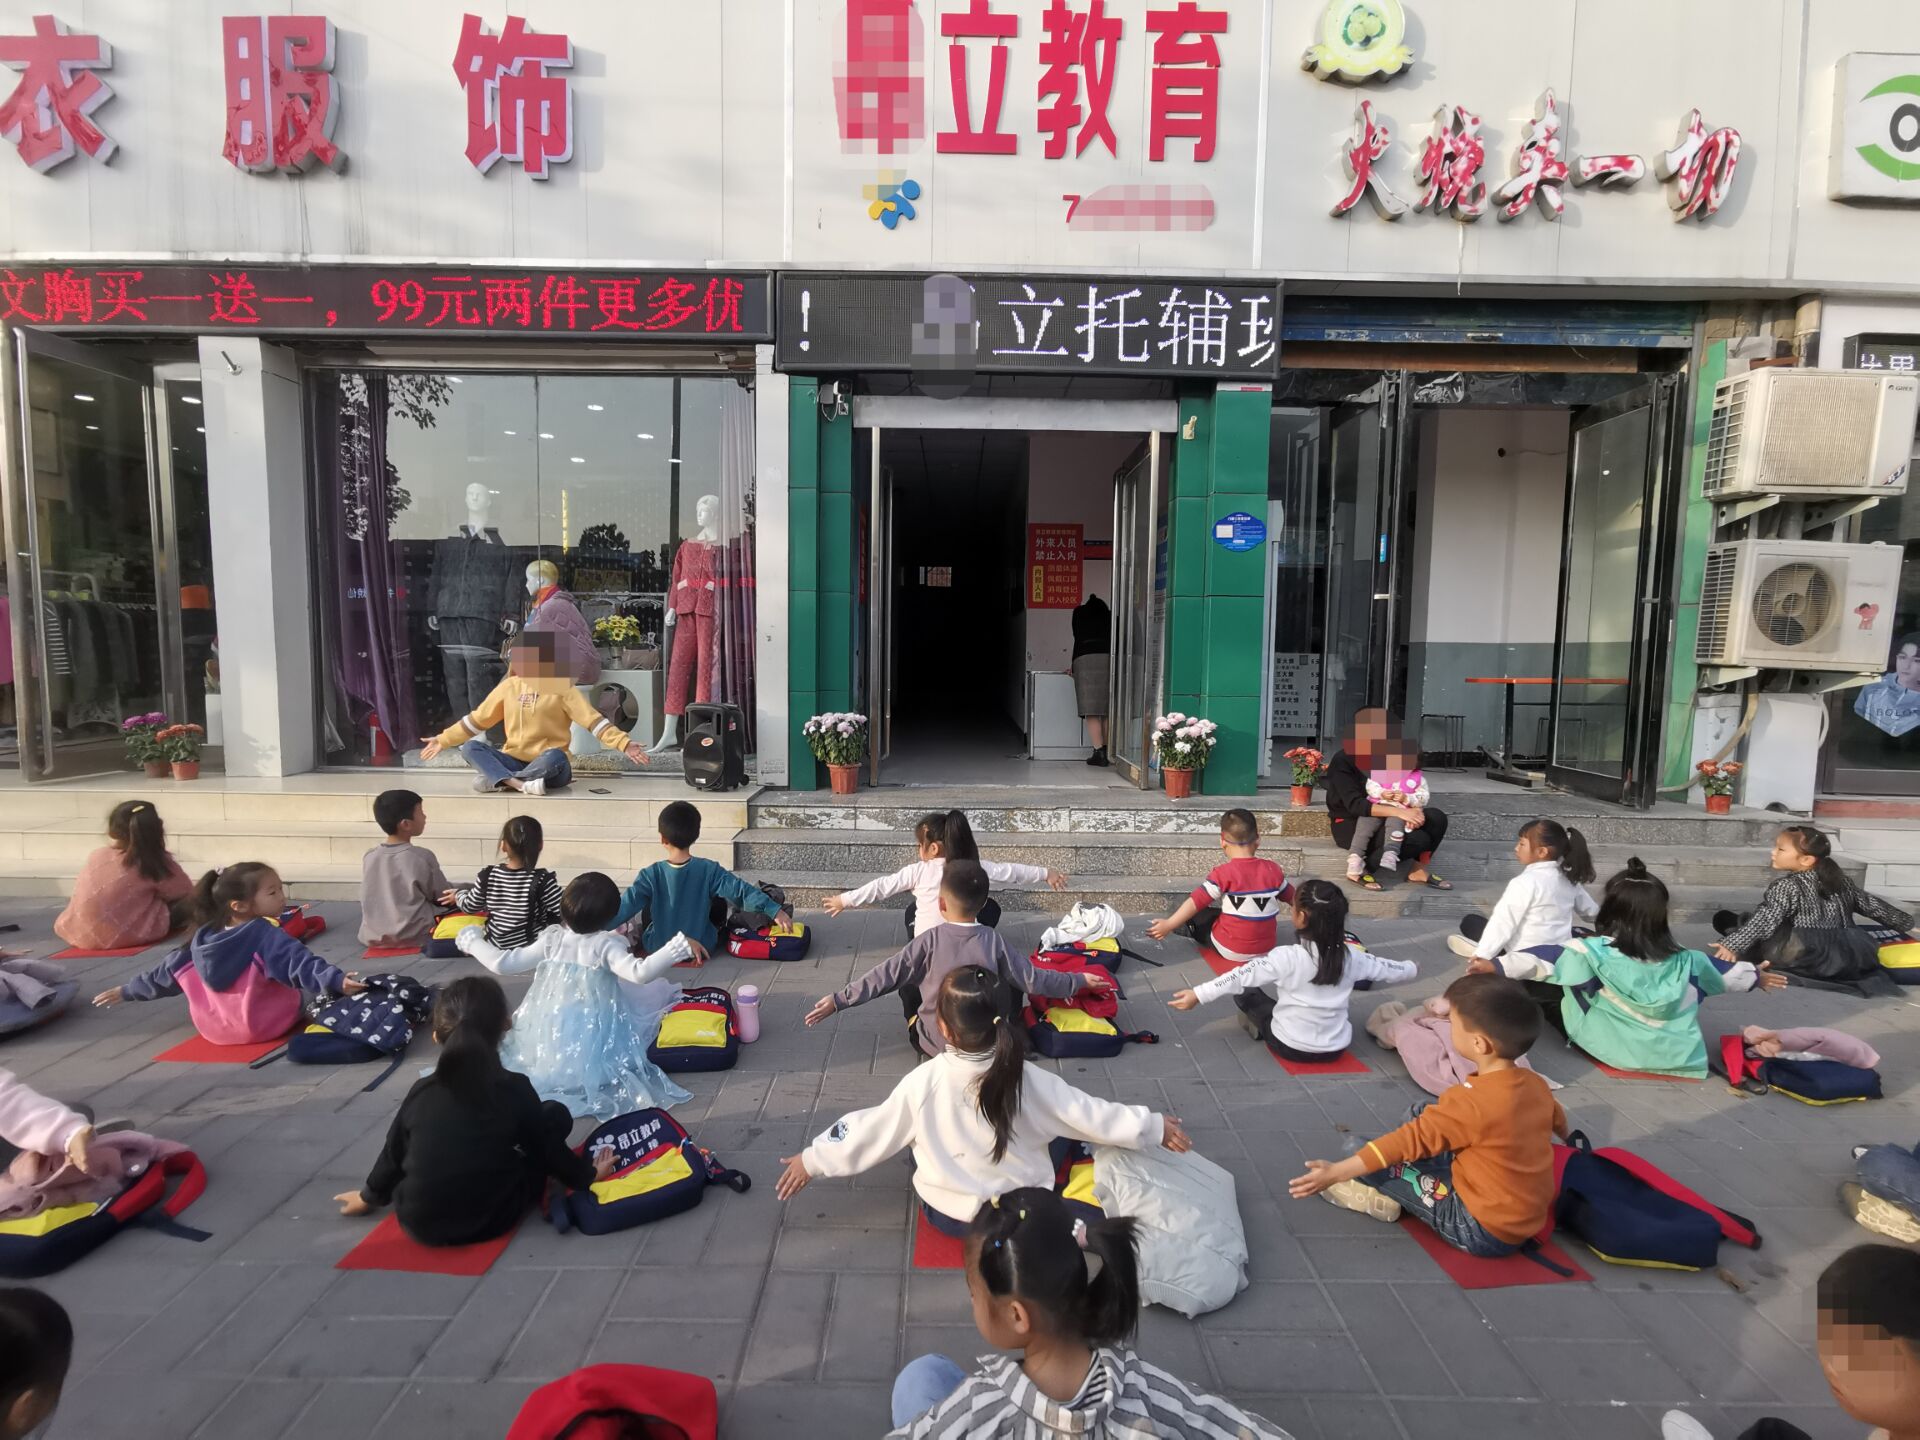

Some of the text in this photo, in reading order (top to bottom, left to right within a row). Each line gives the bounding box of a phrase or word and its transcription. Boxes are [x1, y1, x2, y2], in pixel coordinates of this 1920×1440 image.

[833, 0, 1229, 162] 立教育
[1035, 537, 1077, 548] 外来人员
[1035, 550, 1077, 561] 禁止入内
[617, 1118, 661, 1150] 昂立教育
